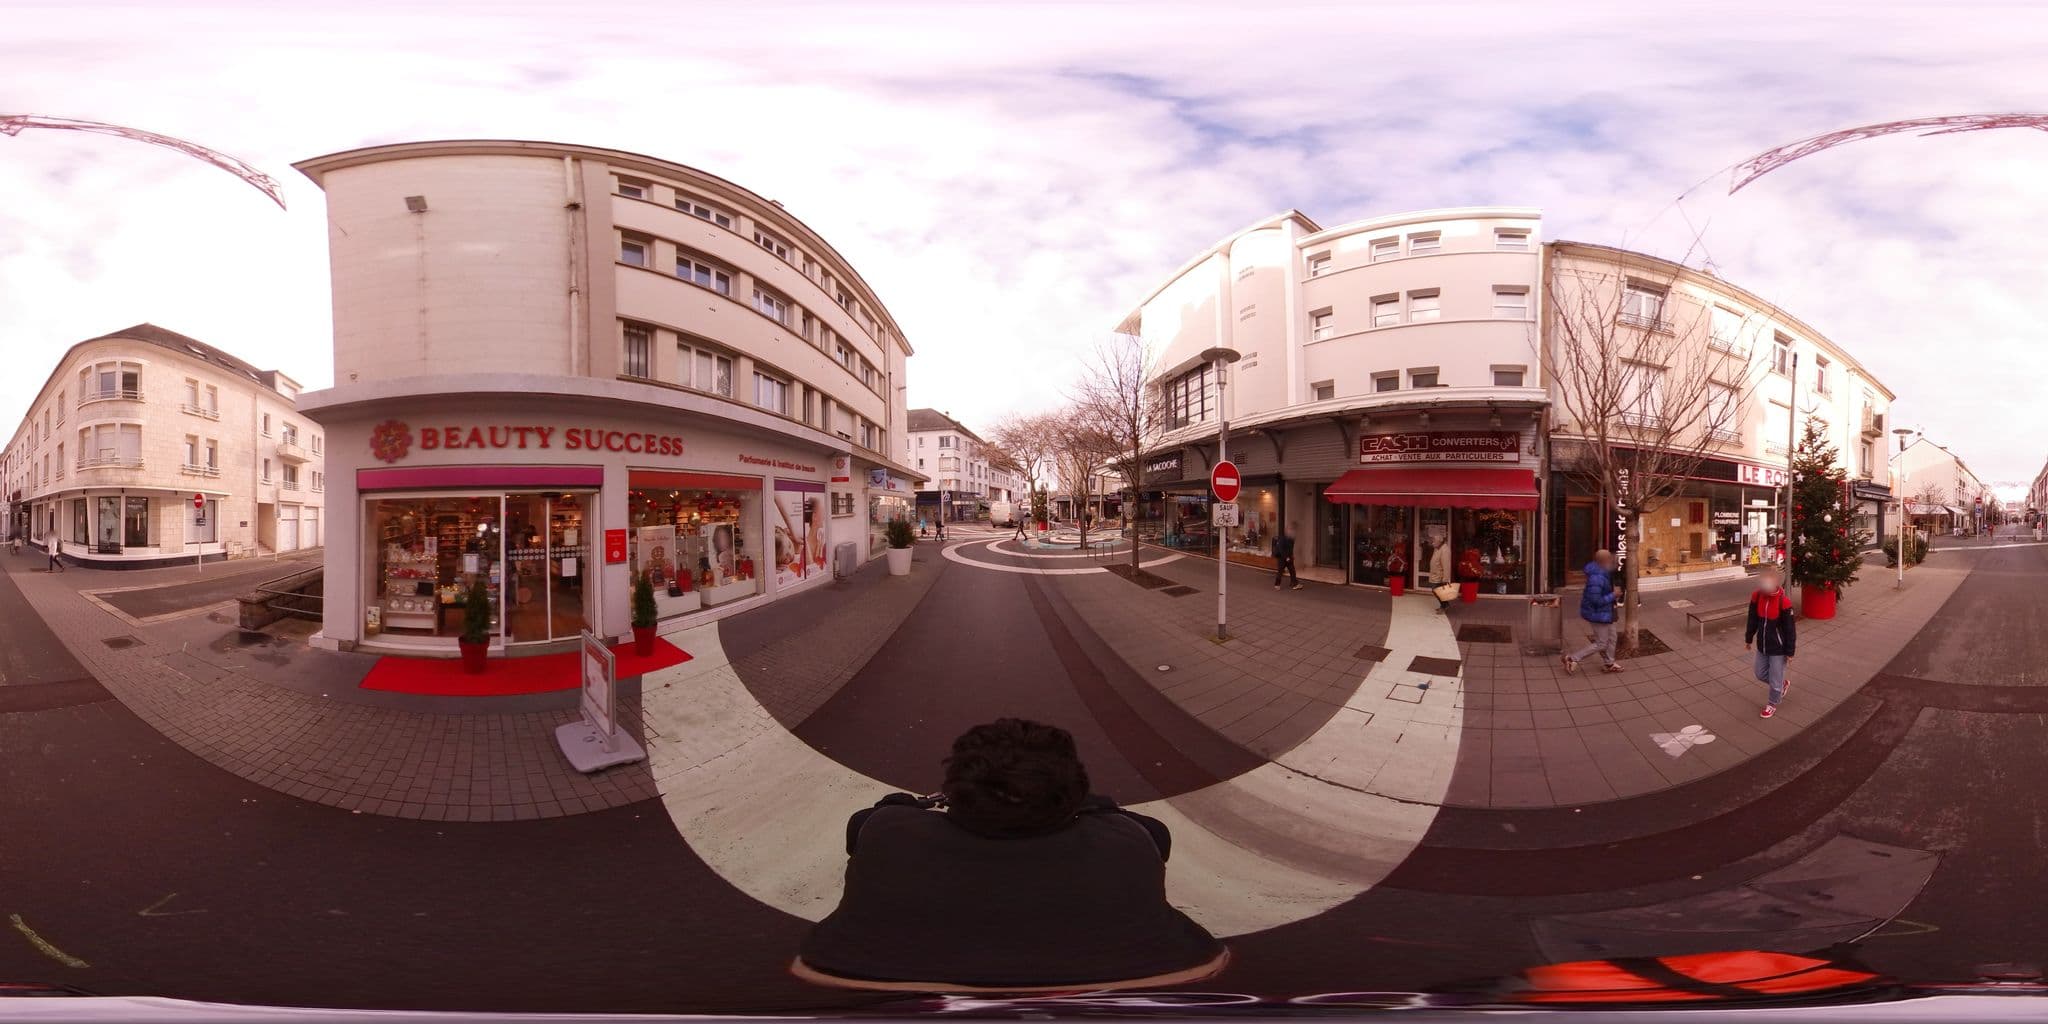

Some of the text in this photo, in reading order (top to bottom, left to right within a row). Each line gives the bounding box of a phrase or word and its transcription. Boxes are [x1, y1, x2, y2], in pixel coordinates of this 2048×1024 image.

[421, 426, 684, 457] BEAUTY SUCCESS
[1432, 438, 1501, 447] CONVERTERS
[739, 454, 771, 467] Parfumerie
[1399, 453, 1422, 461] VENTE
[1146, 459, 1178, 473] LA SACOCHE
[1742, 466, 1760, 483] LE
